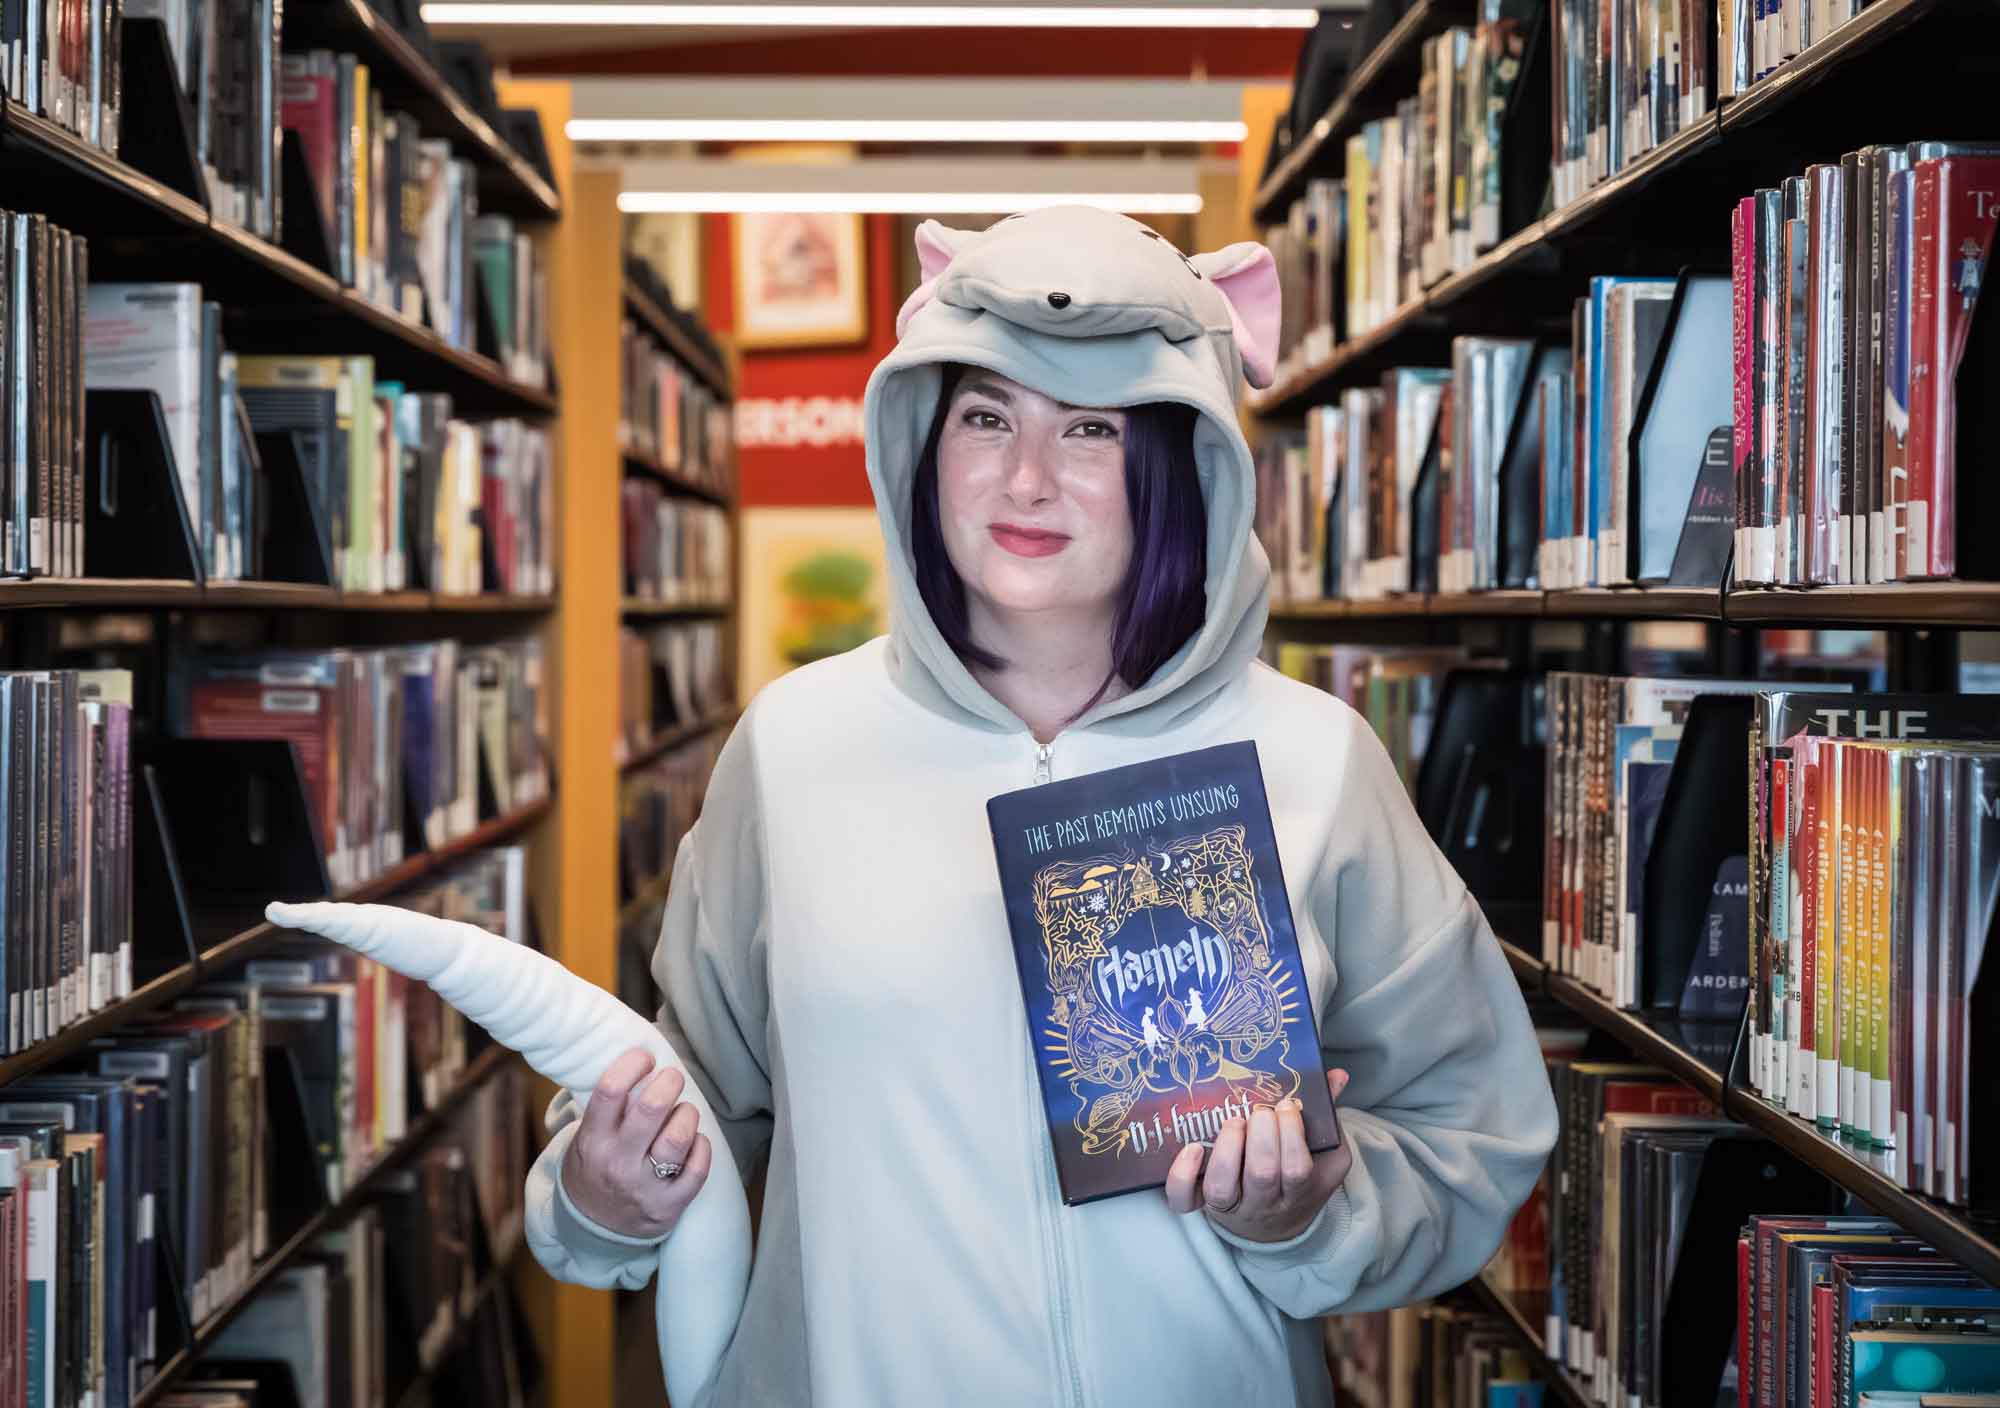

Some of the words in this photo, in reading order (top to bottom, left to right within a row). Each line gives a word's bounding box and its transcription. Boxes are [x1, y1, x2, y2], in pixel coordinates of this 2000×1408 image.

[1815, 708, 1928, 738] THE
[1024, 822, 1053, 855] THE
[1056, 816, 1091, 848] PAST
[1093, 800, 1167, 839] REMAINS
[1170, 784, 1239, 821] UNSUNG
[1806, 847, 1815, 929] AVIATOR'S
[1818, 820, 1830, 942] California
[1841, 823, 1853, 944] California
[1856, 826, 1869, 949] California
[1871, 828, 1884, 952] California
[1097, 926, 1227, 1008] Hameln
